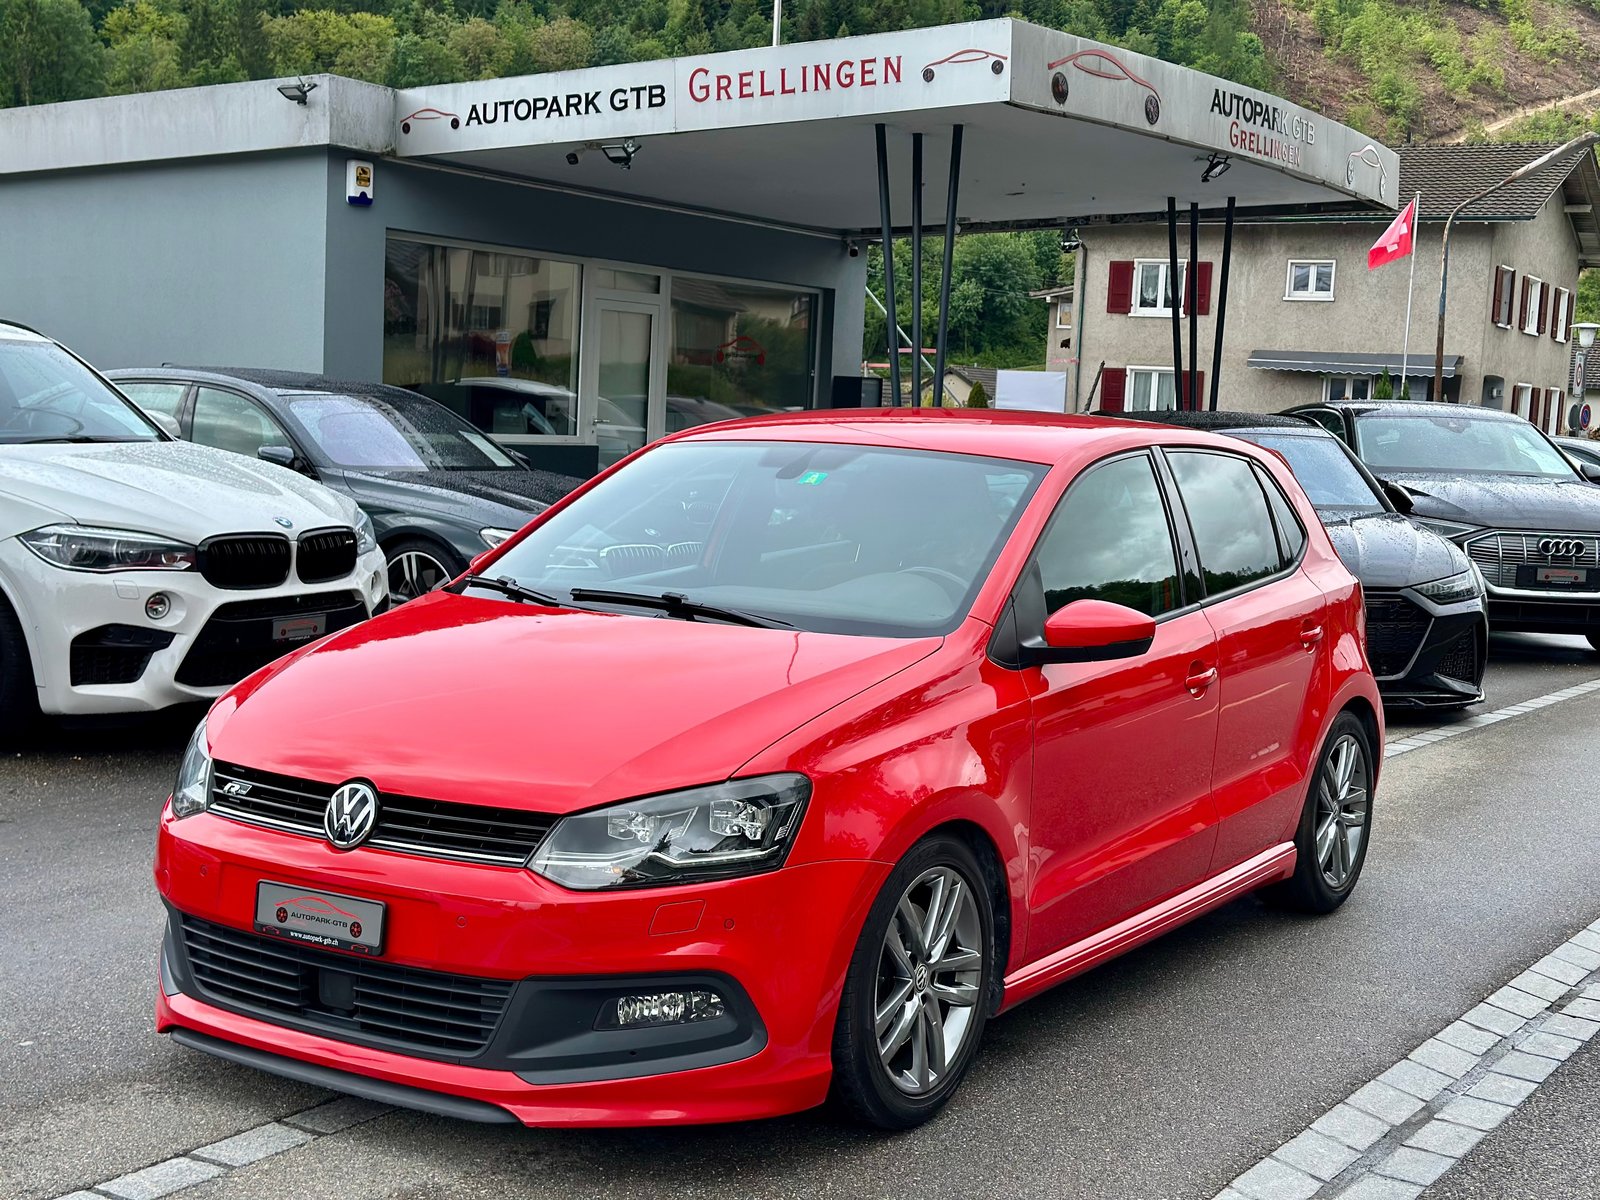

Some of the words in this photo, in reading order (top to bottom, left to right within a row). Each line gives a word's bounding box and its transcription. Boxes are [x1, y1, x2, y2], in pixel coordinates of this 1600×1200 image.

[465, 90, 602, 127] AUTOPARK
[609, 84, 667, 112] GTB
[688, 55, 903, 104] GRELLINGEN
[1210, 88, 1289, 137] AUTOPARK
[1291, 114, 1316, 146] GTB
[1229, 120, 1300, 168] GRELLINGEN
[289, 930, 339, 947] www.autopark-gtb.ch
[290, 911, 348, 929] AUTOPARK-GTB
